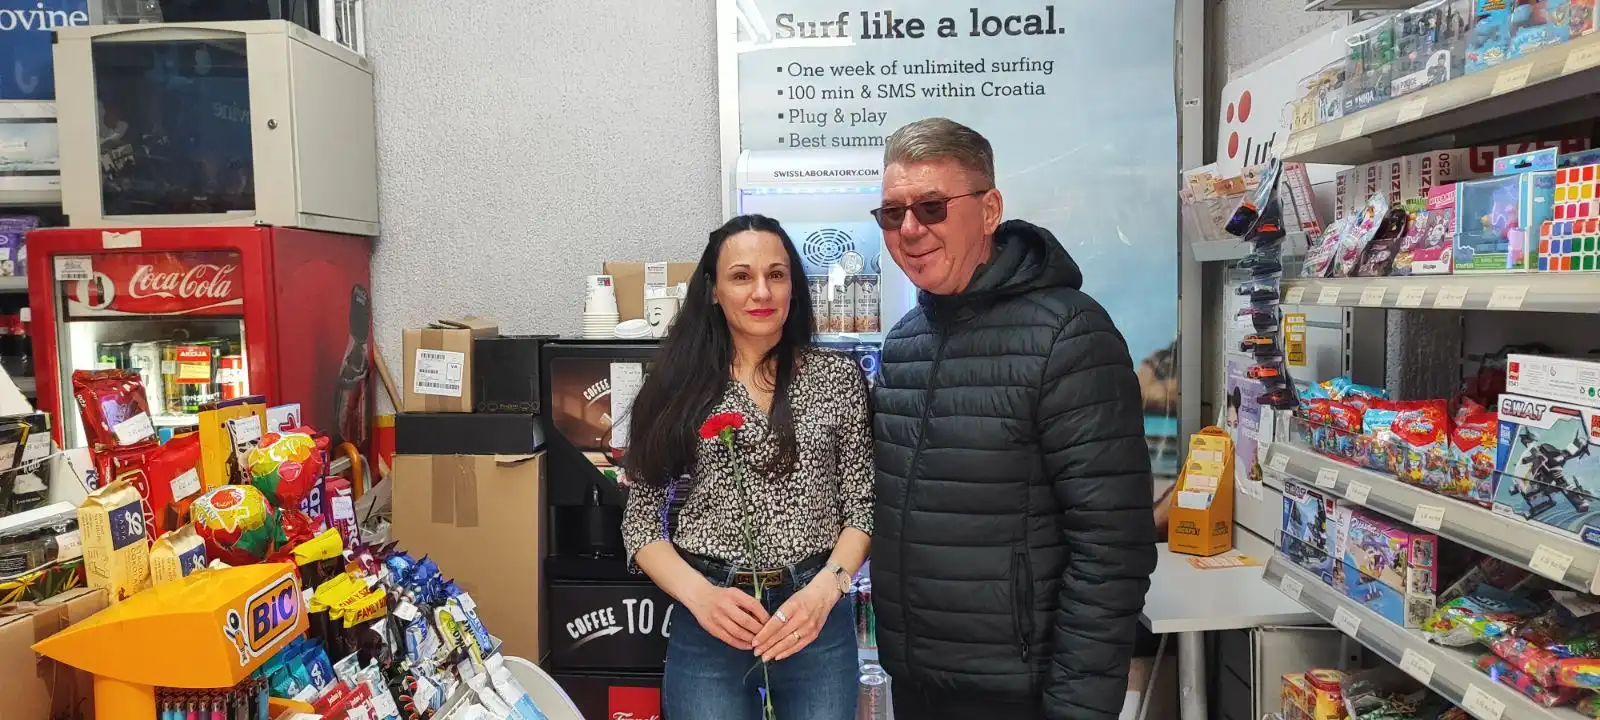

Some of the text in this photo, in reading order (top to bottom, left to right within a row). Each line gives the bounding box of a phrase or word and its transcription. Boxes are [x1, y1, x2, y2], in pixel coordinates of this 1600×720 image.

[0, 2, 88, 30] ovine
[775, 5, 1066, 39] Surf like a local.
[788, 57, 1055, 77] One week of unlimited surfing
[788, 81, 1046, 100] 100 min & SMS within Croatia
[789, 107, 888, 127] Plug & play
[789, 133, 827, 148] Best
[773, 169, 879, 178] SWISSLABORATORY.COM
[1439, 153, 1450, 176] 250
[1367, 166, 1376, 200] GIZ
[128, 264, 237, 299] Coca-Cola
[583, 378, 611, 401] COFFEE
[253, 585, 294, 642] BiC
[357, 602, 380, 620] FAMILY
[566, 607, 616, 639] COFFEE
[622, 598, 654, 635] TO
